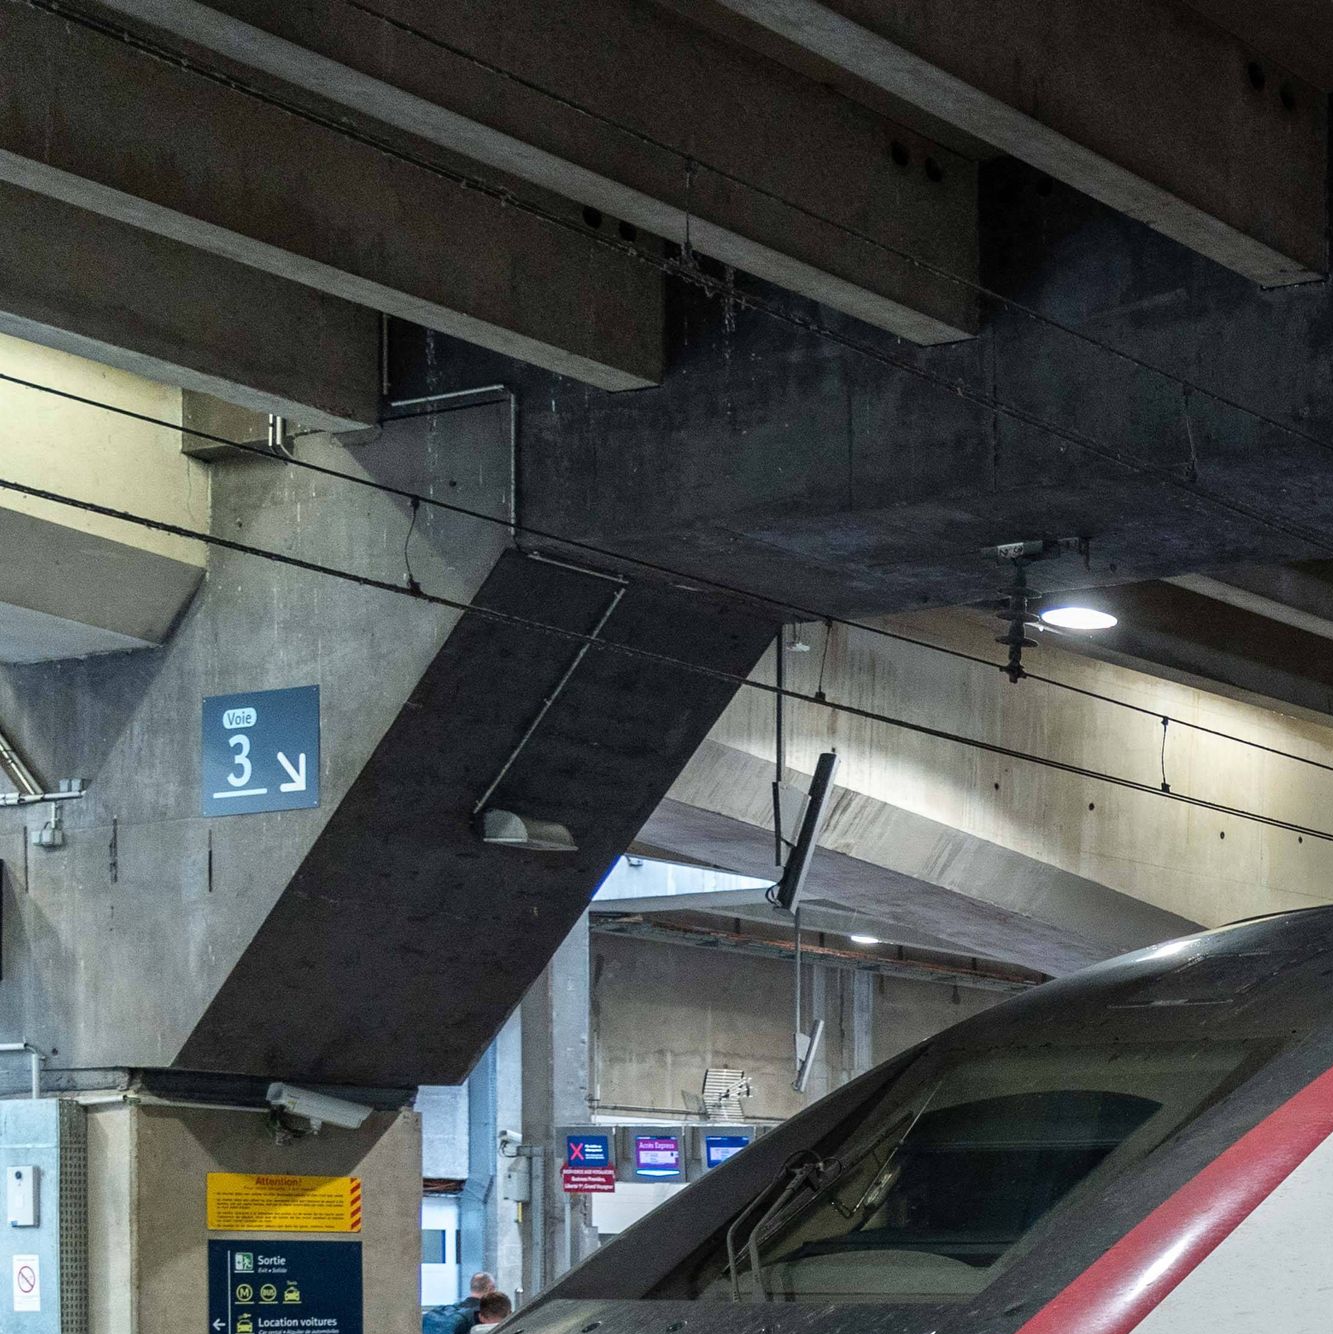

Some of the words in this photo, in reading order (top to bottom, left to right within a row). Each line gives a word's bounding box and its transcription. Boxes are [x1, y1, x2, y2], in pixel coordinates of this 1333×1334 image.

[226, 711, 252, 726] Voie
[226, 734, 252, 787] 3
[257, 1255, 286, 1265] Sortie
[258, 1317, 298, 1327] Location
[300, 1317, 337, 1327] voitures
